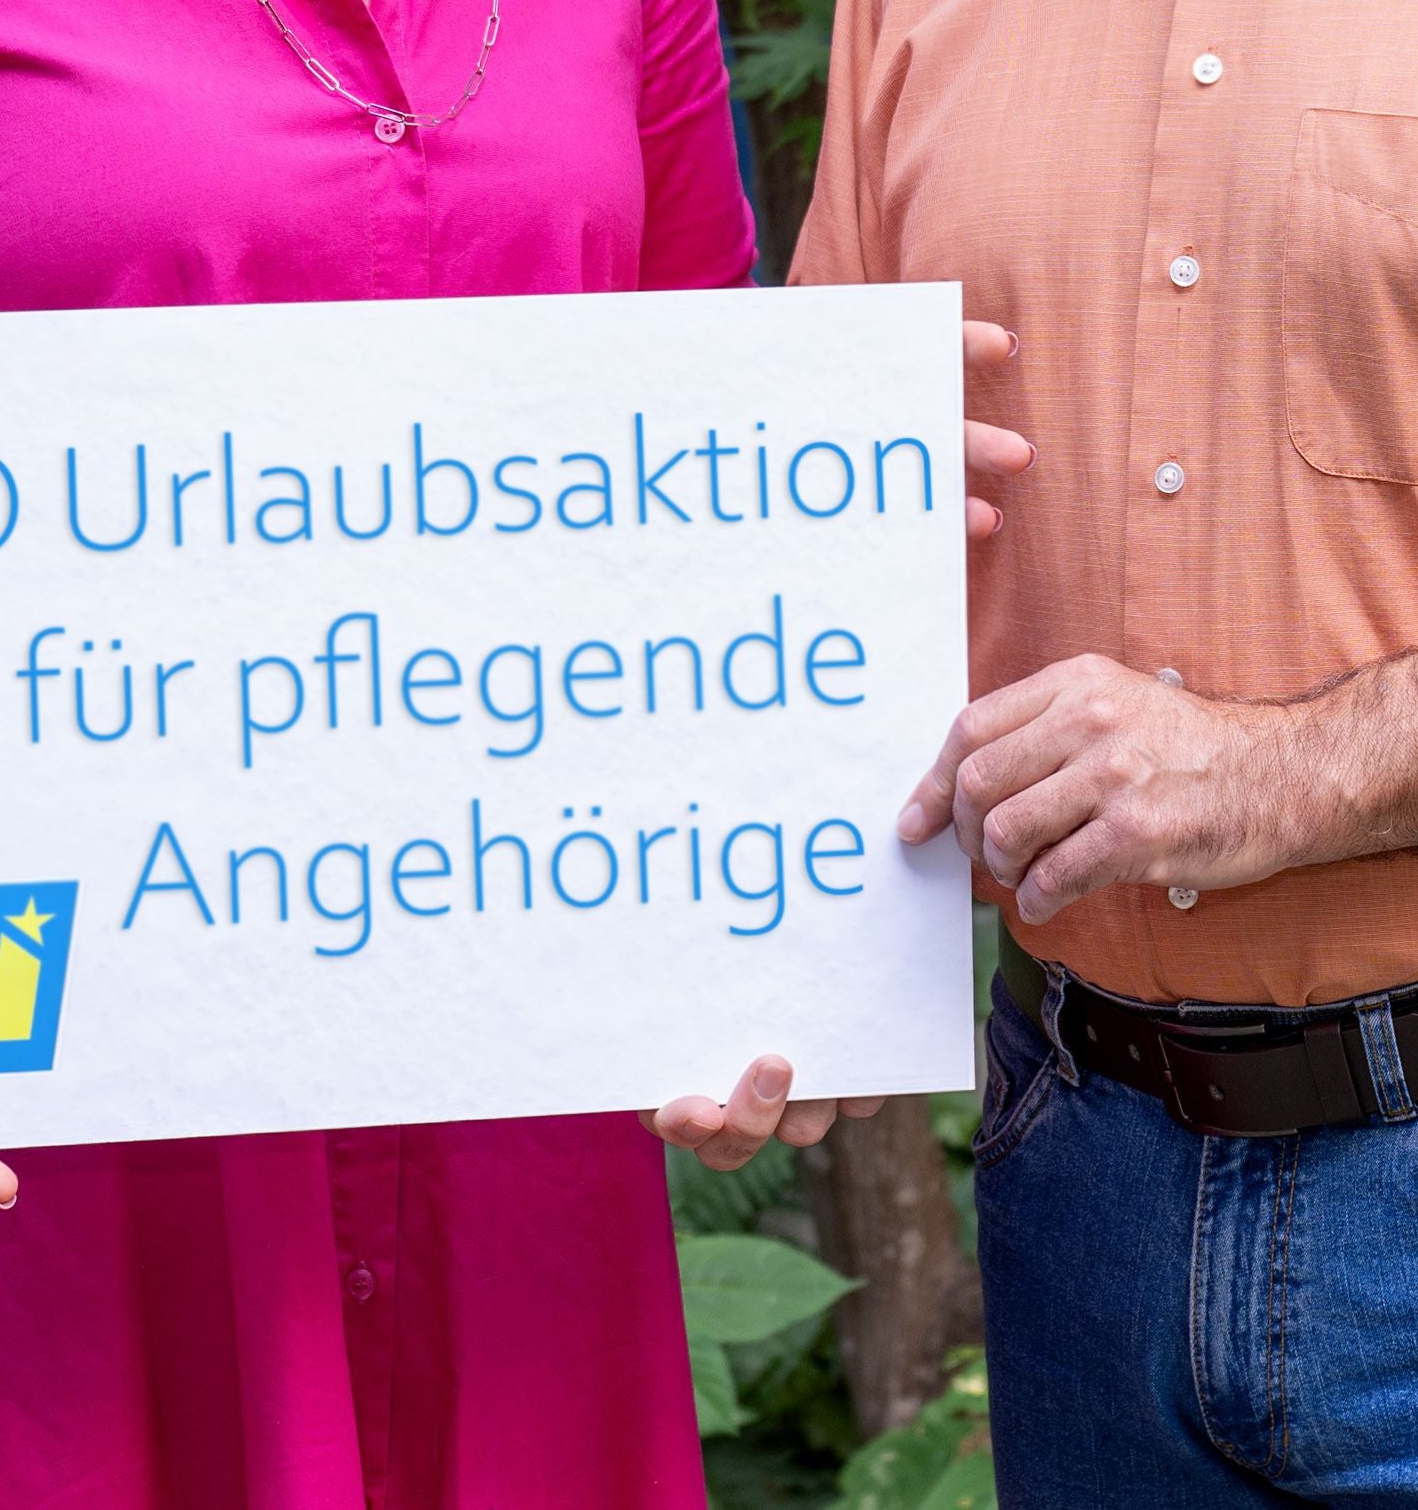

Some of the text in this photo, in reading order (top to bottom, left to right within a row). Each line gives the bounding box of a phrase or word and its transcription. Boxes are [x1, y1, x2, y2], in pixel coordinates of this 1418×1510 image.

[64, 410, 935, 555] Urlaubsaktion
[13, 591, 868, 772] für pflegende
[119, 795, 867, 960] Angehörige
